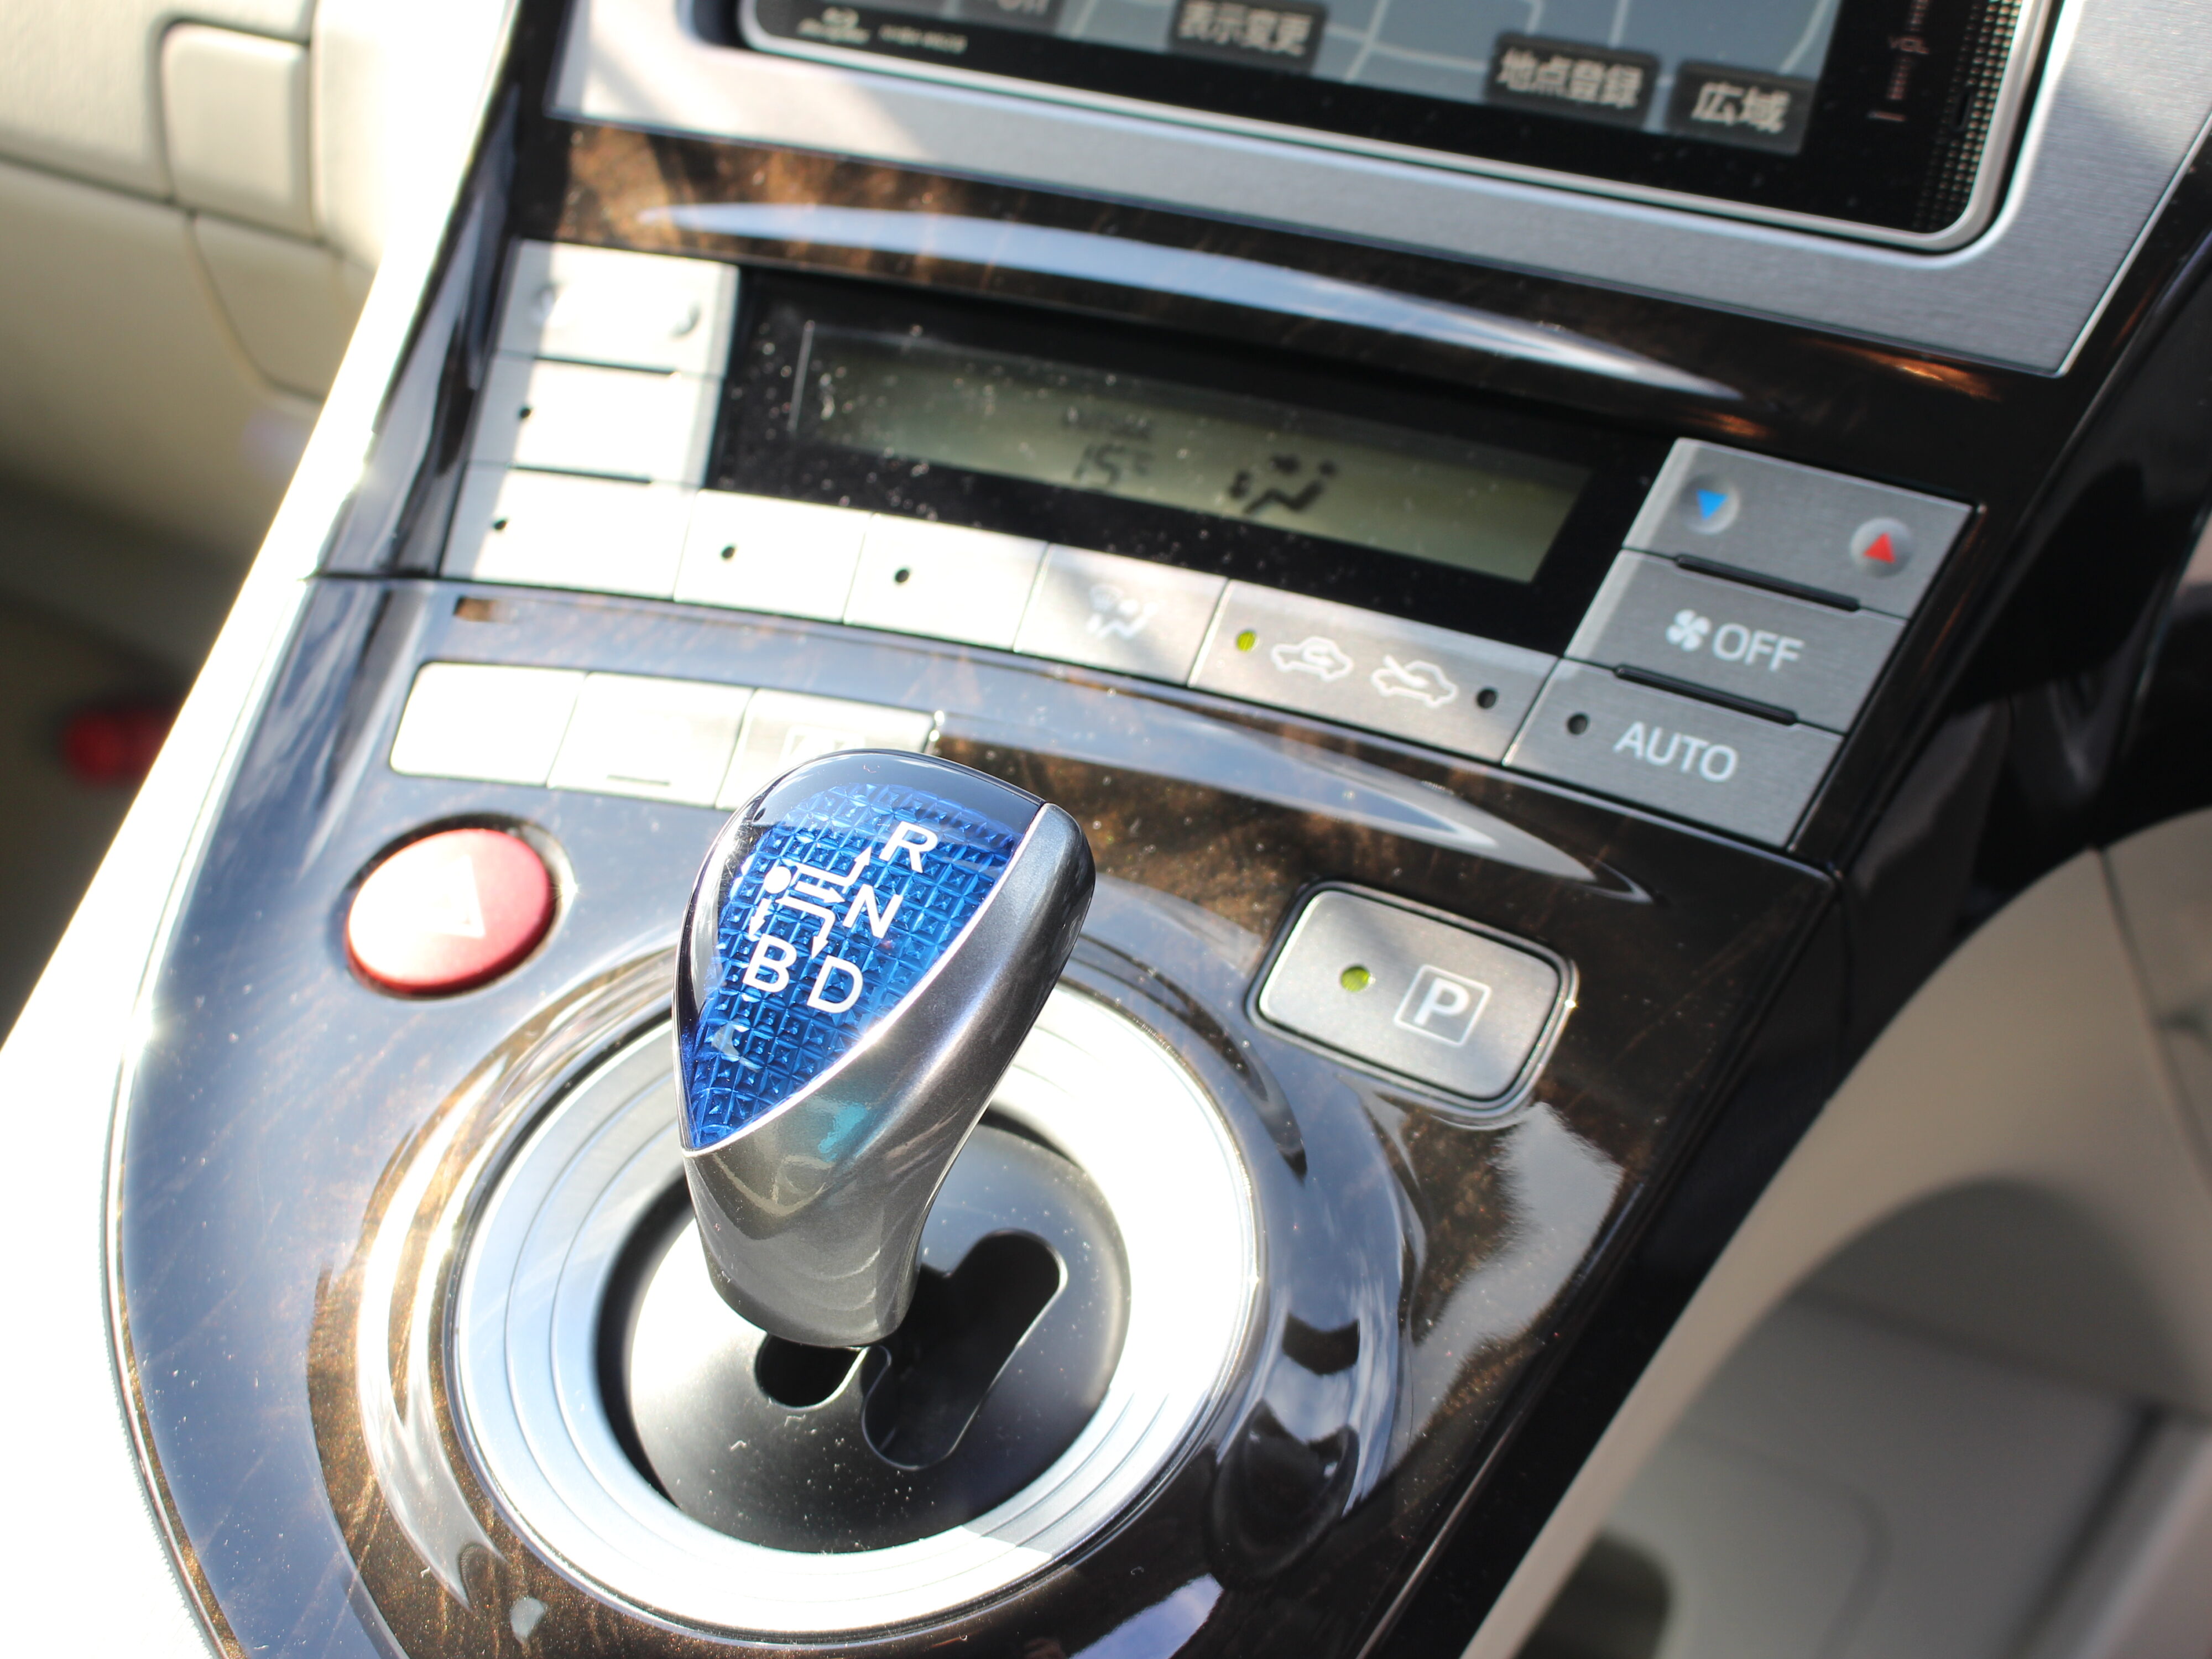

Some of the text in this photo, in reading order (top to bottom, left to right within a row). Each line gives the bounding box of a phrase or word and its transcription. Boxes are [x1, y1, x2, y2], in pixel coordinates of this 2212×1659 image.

[1496, 48, 1643, 109] 地点登録
[1690, 81, 1790, 134] 広域
[1712, 622, 1805, 671] OFF
[1613, 721, 1739, 784] AUTO
[879, 821, 939, 873] R
[842, 884, 904, 938] N
[742, 933, 797, 993] B
[806, 955, 864, 1014] D
[1413, 977, 1470, 1027] P
